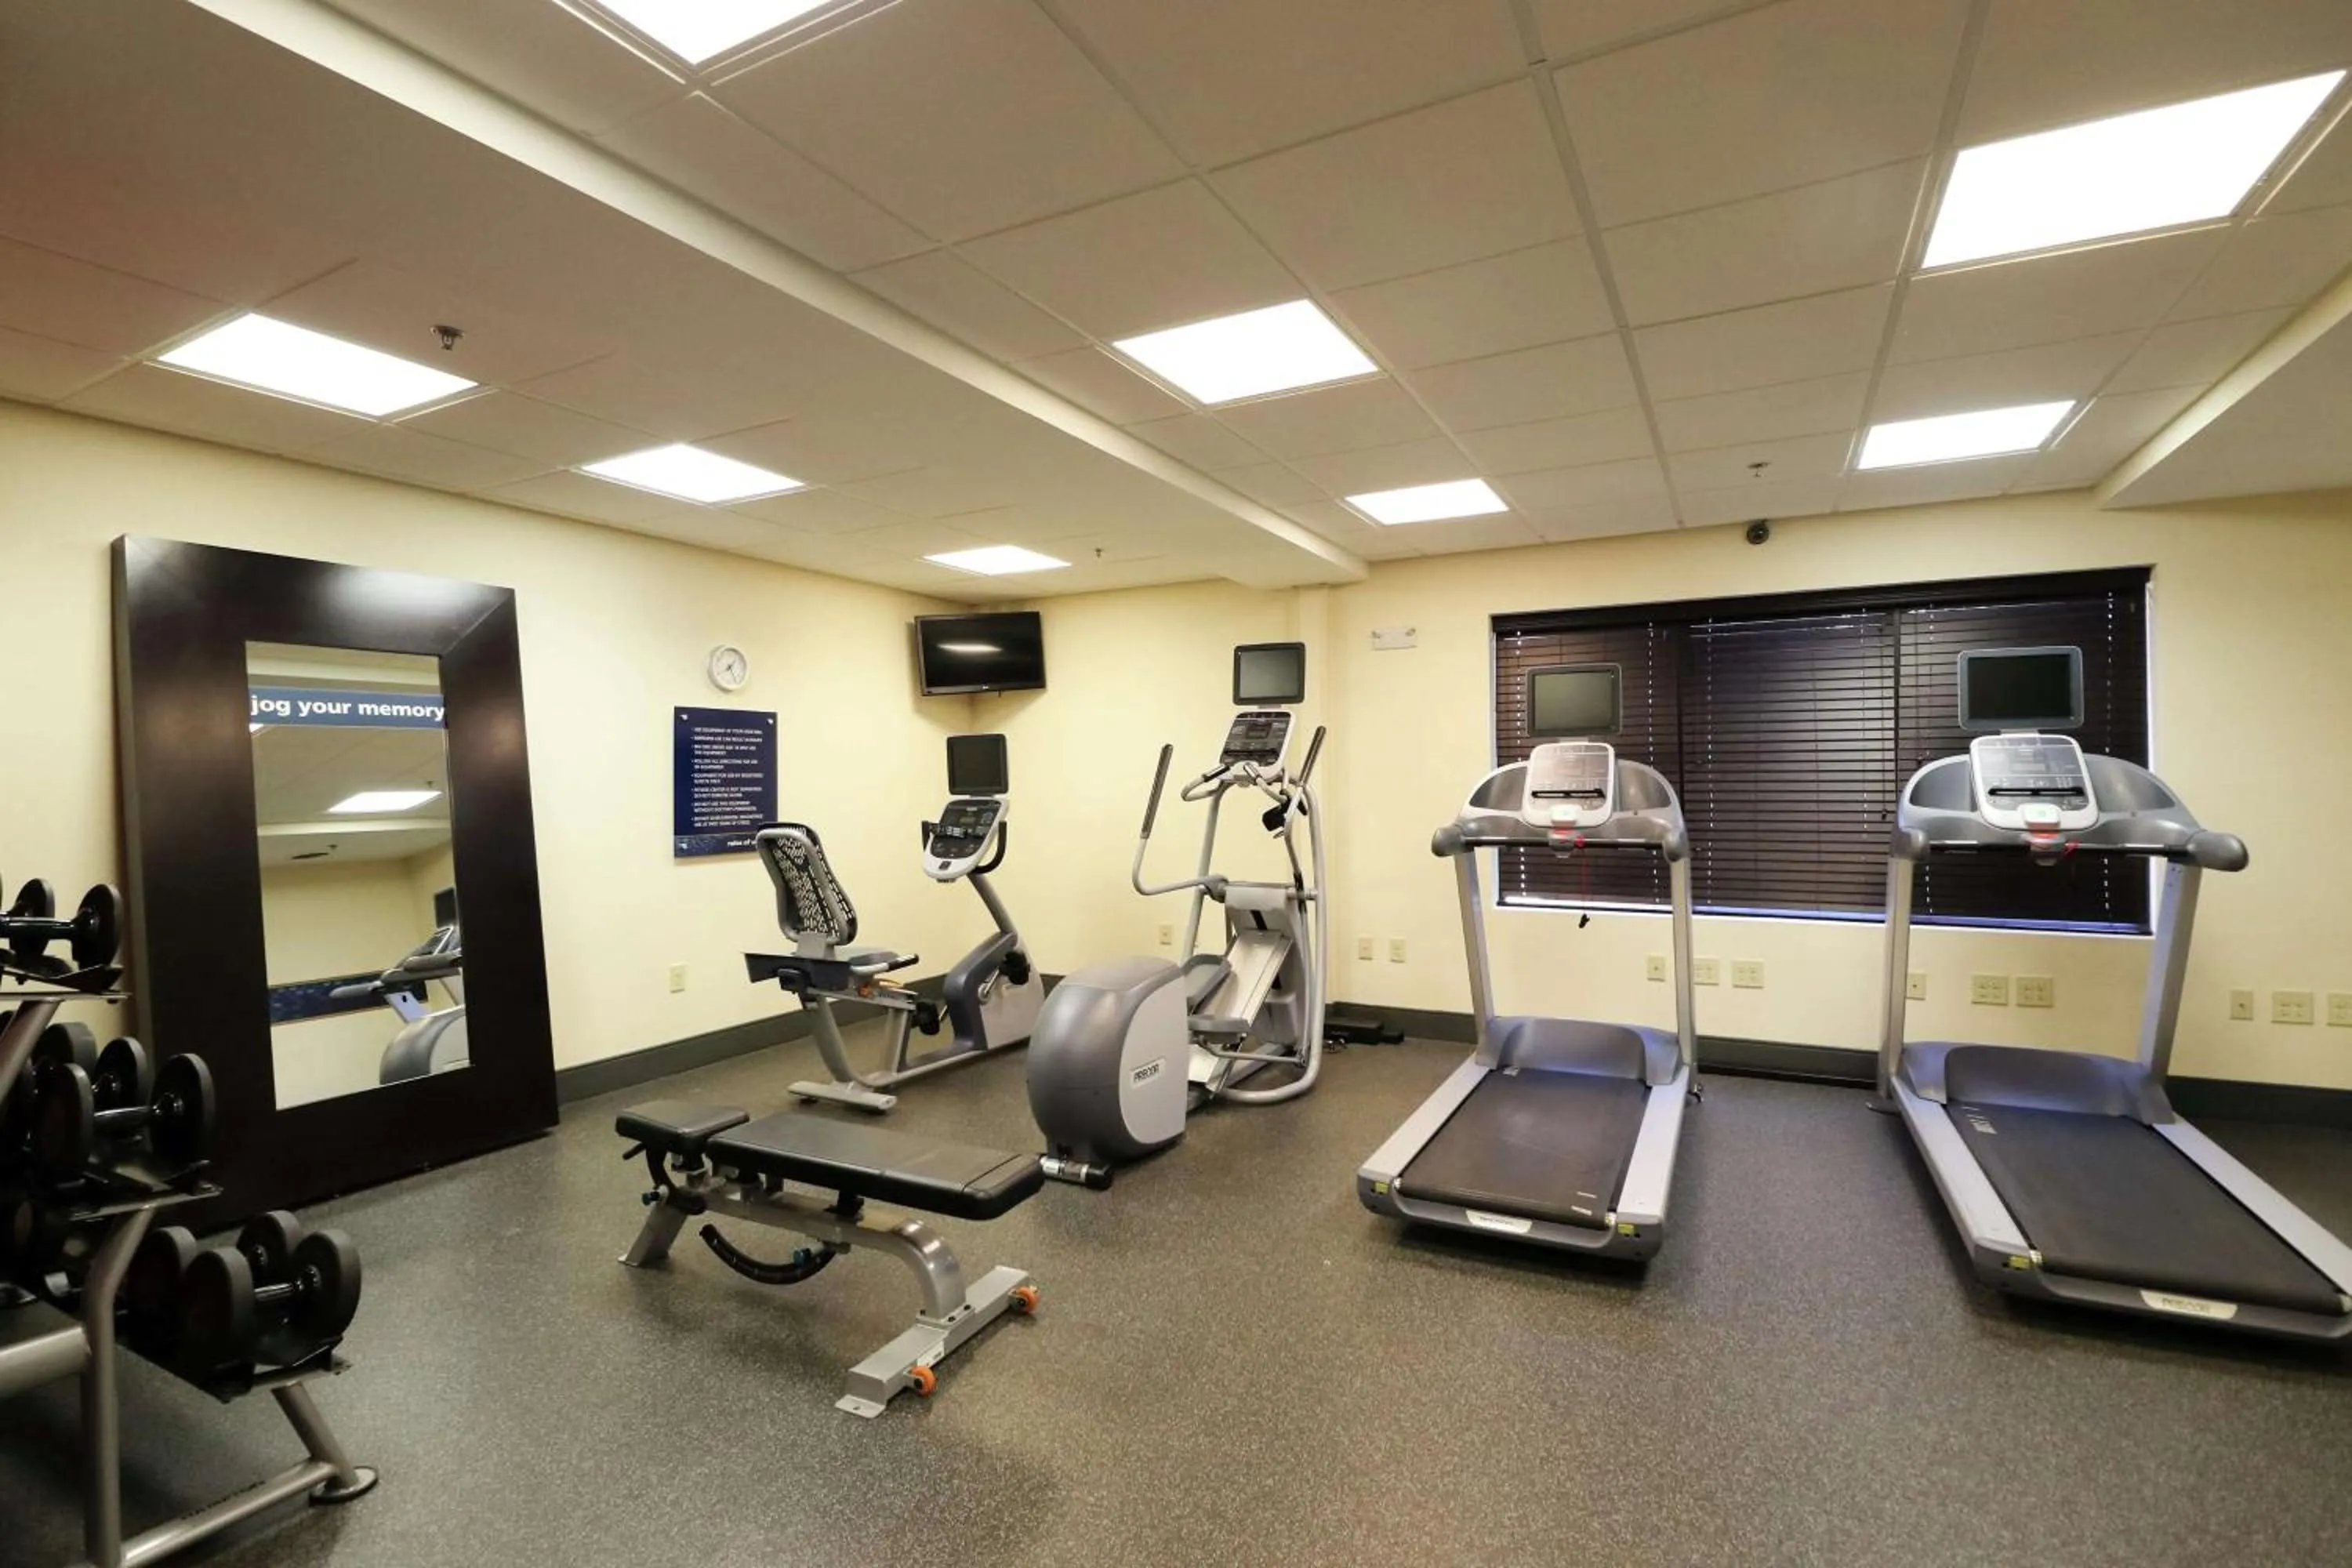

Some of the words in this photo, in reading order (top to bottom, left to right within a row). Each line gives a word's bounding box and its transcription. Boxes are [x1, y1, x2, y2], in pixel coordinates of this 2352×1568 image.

[251, 695, 292, 717] jog
[298, 699, 351, 717] your
[358, 702, 445, 720] memory
